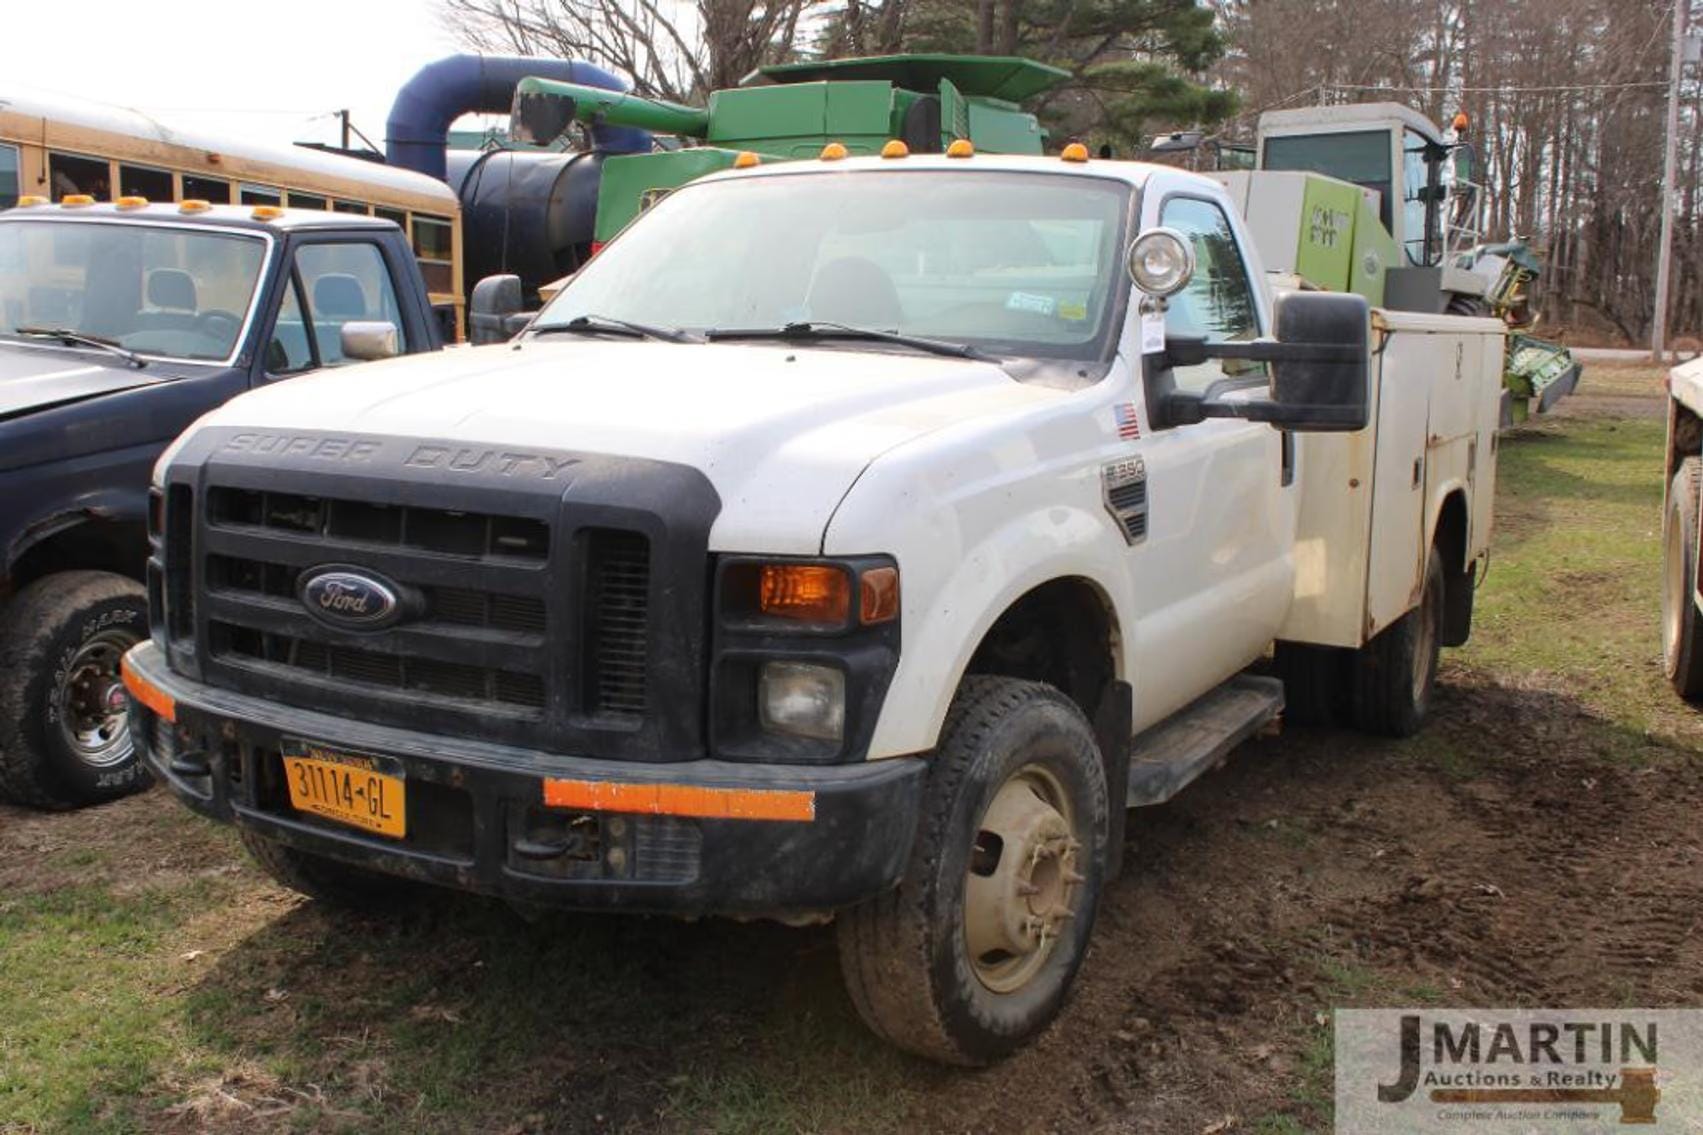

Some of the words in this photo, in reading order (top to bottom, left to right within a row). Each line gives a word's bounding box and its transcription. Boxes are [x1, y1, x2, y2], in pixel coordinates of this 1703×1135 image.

[224, 433, 382, 463] SUPER
[404, 445, 583, 480] DUTY
[320, 582, 368, 613] Ford
